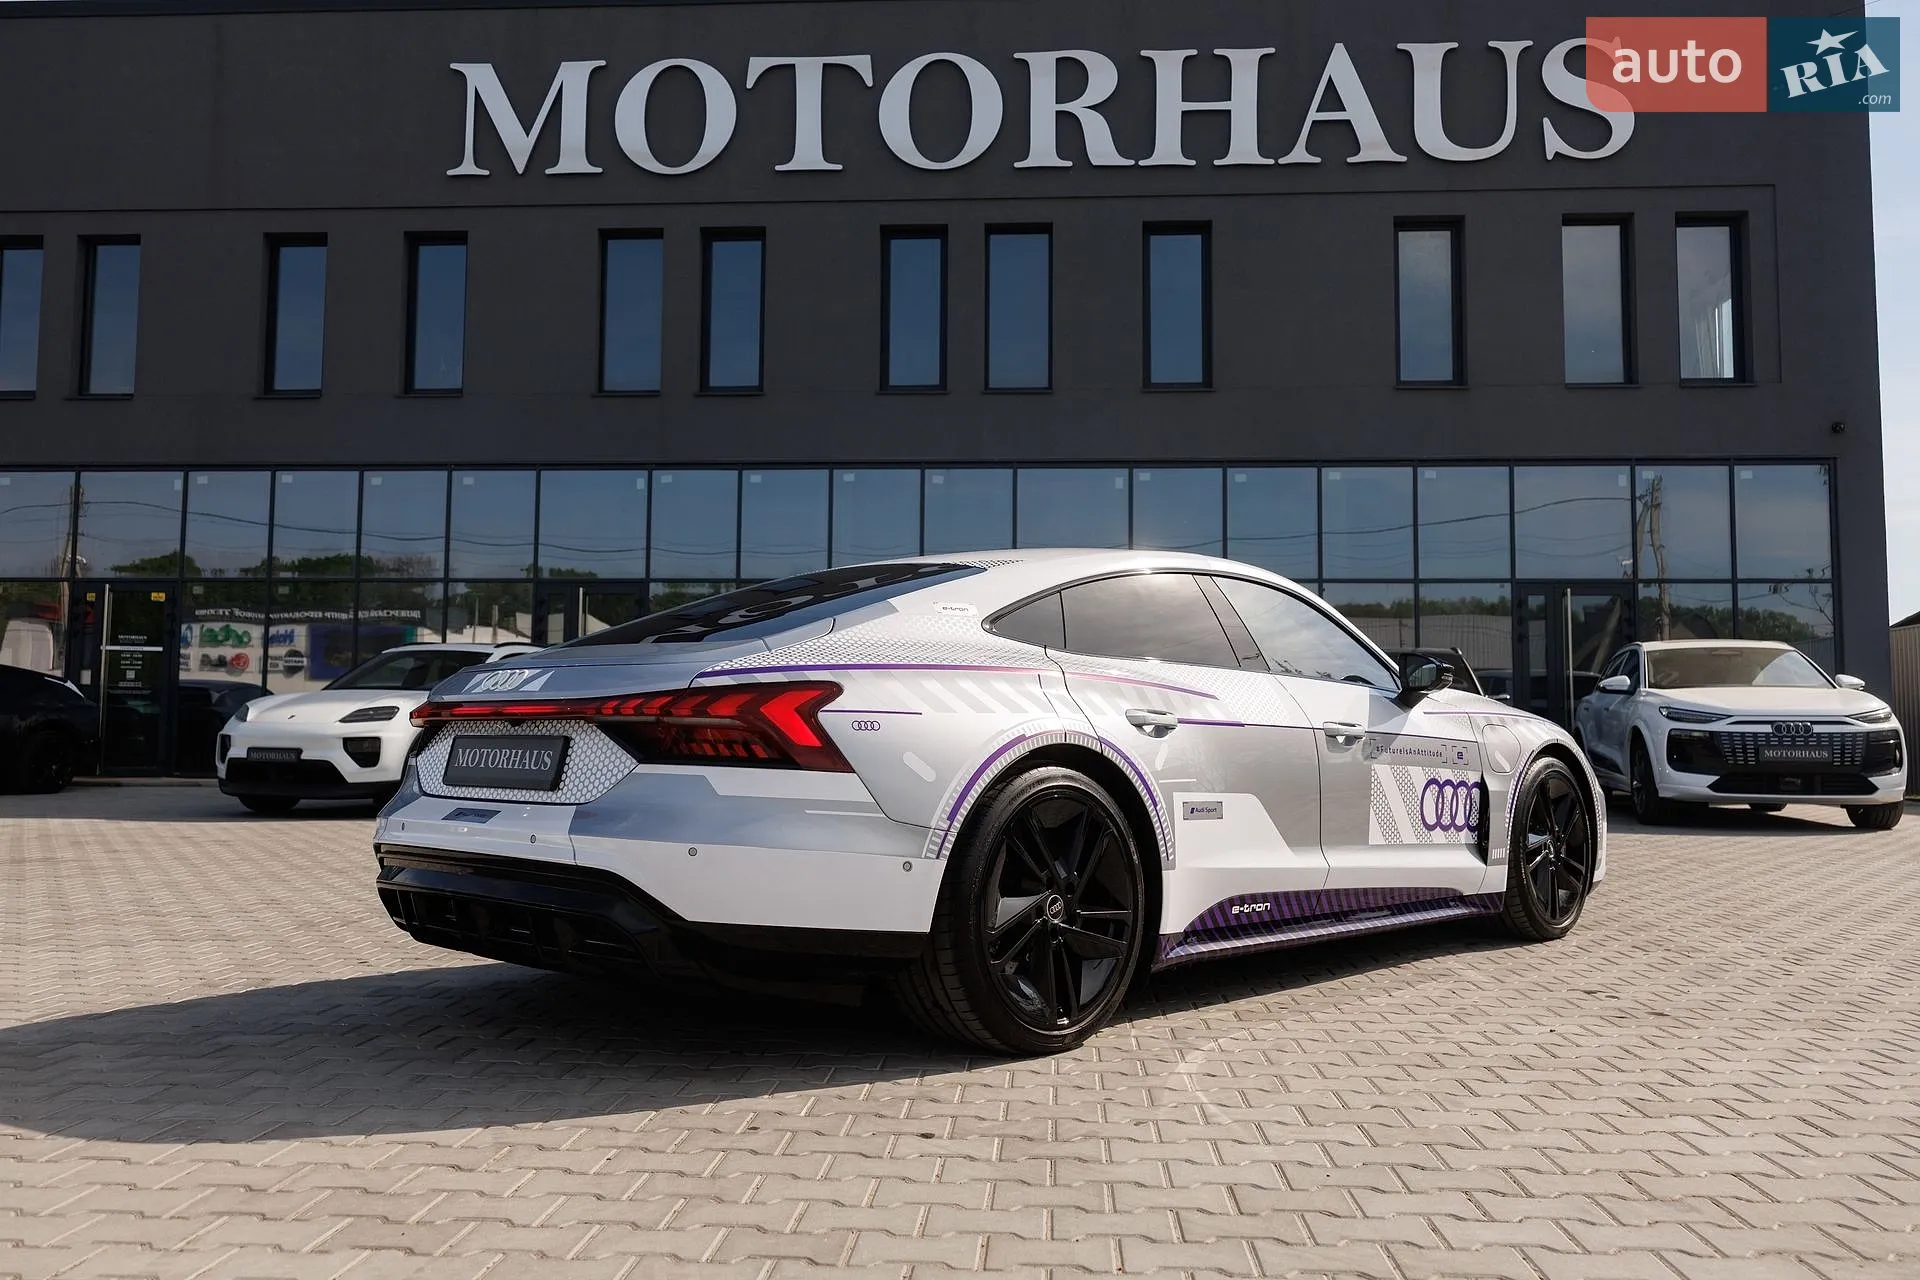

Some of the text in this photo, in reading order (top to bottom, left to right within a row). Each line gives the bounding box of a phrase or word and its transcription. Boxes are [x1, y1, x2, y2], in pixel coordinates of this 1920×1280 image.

[446, 37, 1636, 177] MOTORHAUS
[454, 748, 553, 771] MOTORHAUS
[1764, 749, 1829, 758] MOTORHAUS
[1231, 902, 1271, 914] e-tron
